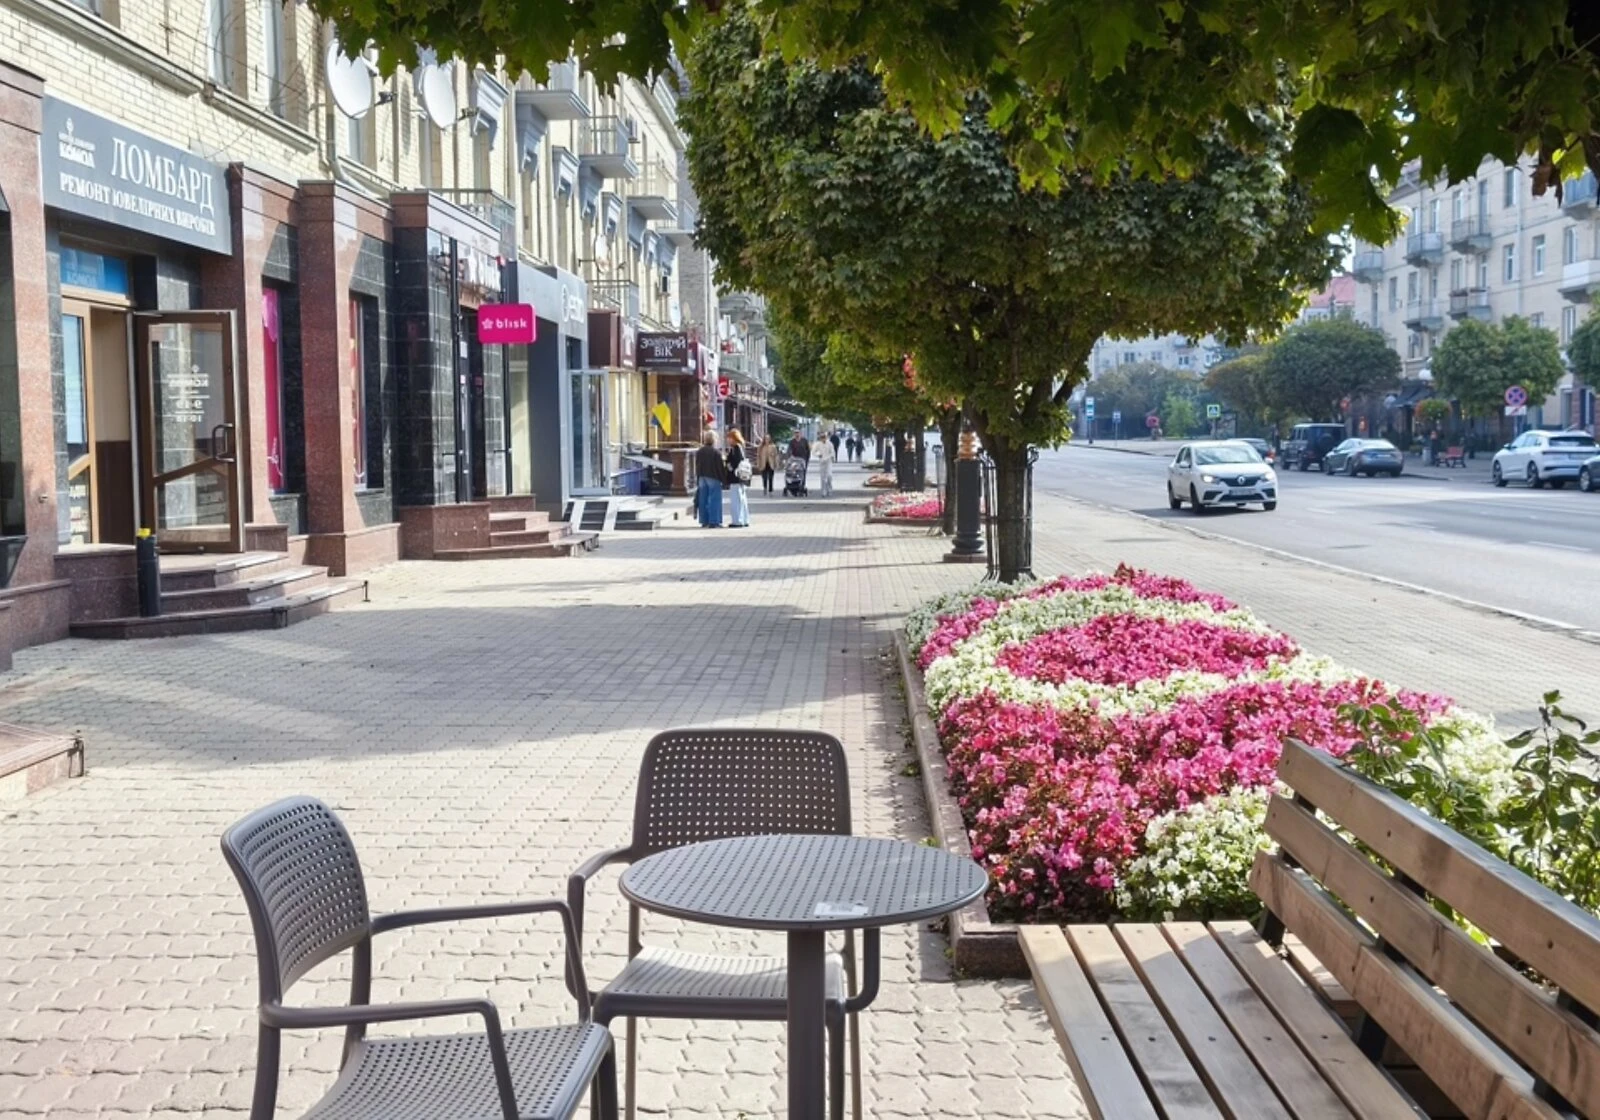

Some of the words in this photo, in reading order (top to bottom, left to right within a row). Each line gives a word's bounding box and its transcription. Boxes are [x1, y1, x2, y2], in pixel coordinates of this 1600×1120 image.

[59, 172, 110, 204] РЕМОНТ
[111, 189, 175, 224] ЮВЕЛІРНИХ
[111, 137, 214, 218] ЛОМБАРД
[496, 318, 527, 329] blisk
